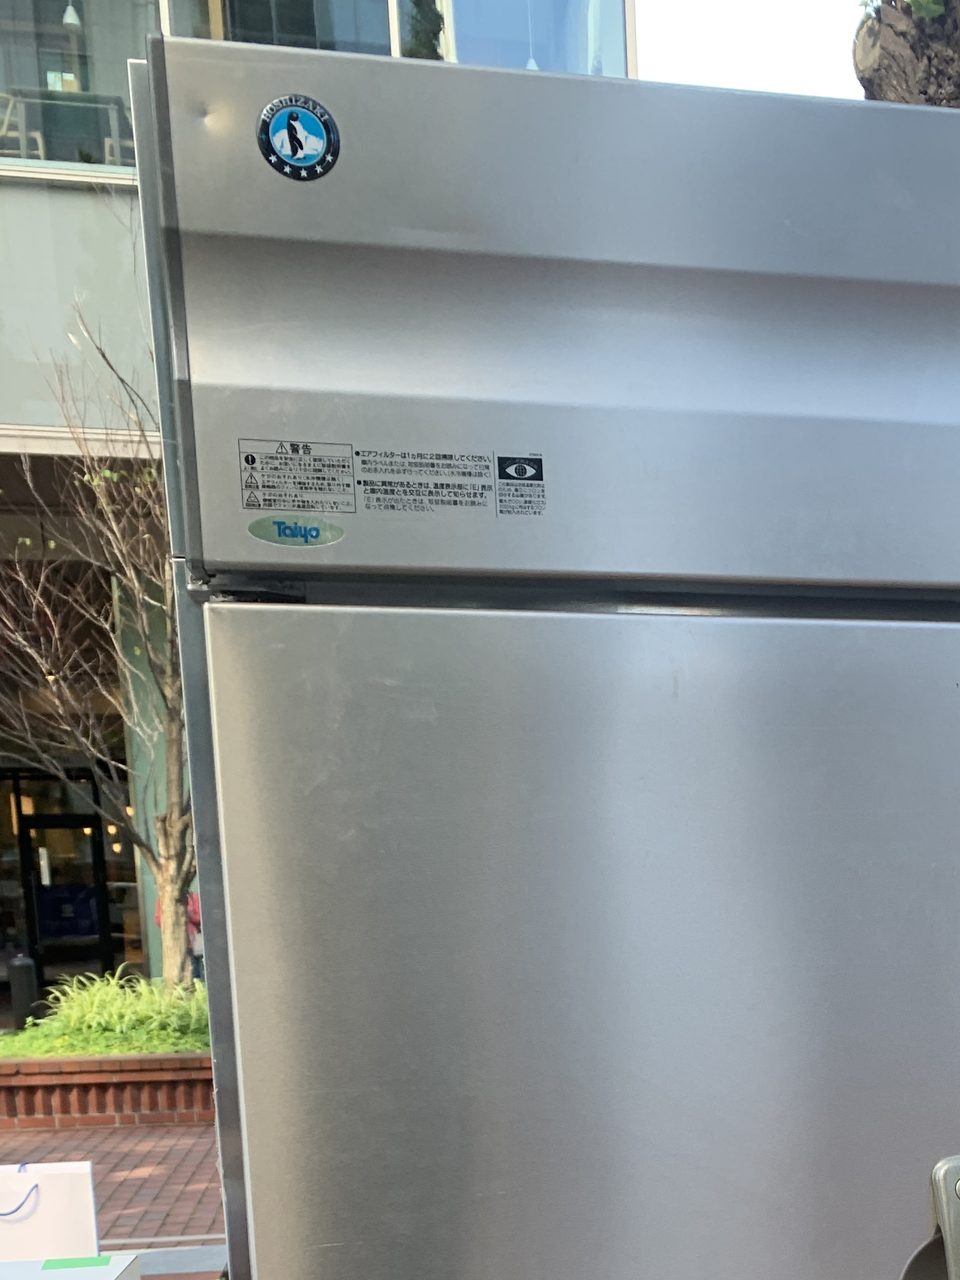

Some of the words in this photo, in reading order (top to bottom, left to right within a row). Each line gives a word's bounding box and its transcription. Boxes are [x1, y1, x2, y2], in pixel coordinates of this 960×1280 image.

[261, 96, 329, 122] HOSHIZAKI
[290, 443, 312, 455] 警告
[272, 520, 320, 543] Taiyo
